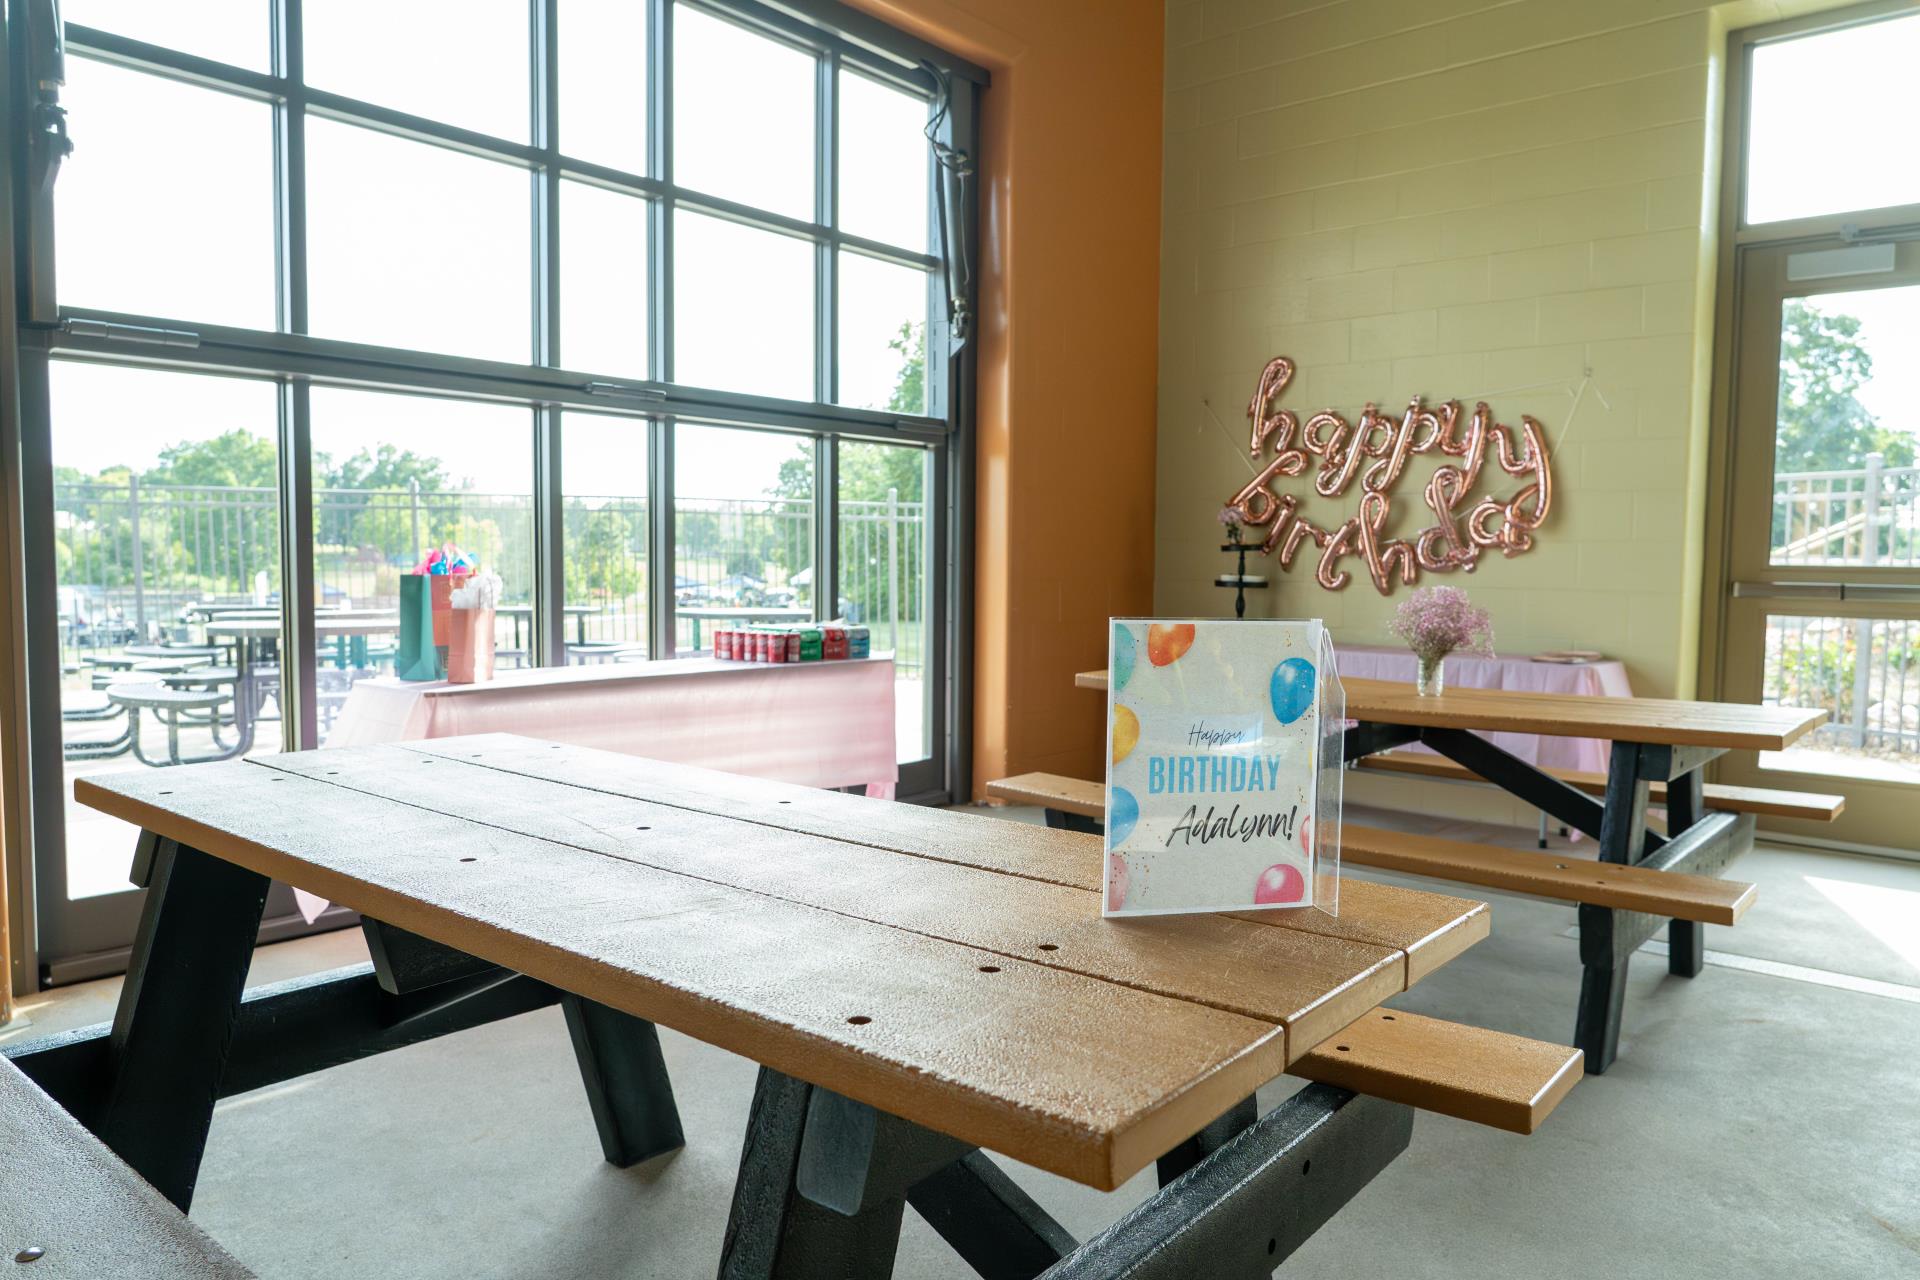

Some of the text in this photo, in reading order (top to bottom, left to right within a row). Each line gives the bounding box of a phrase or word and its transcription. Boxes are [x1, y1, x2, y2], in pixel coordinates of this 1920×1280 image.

[1247, 356, 1490, 509] happy
[1188, 720, 1246, 750] Happy
[1148, 754, 1281, 794] BIRTHDAY
